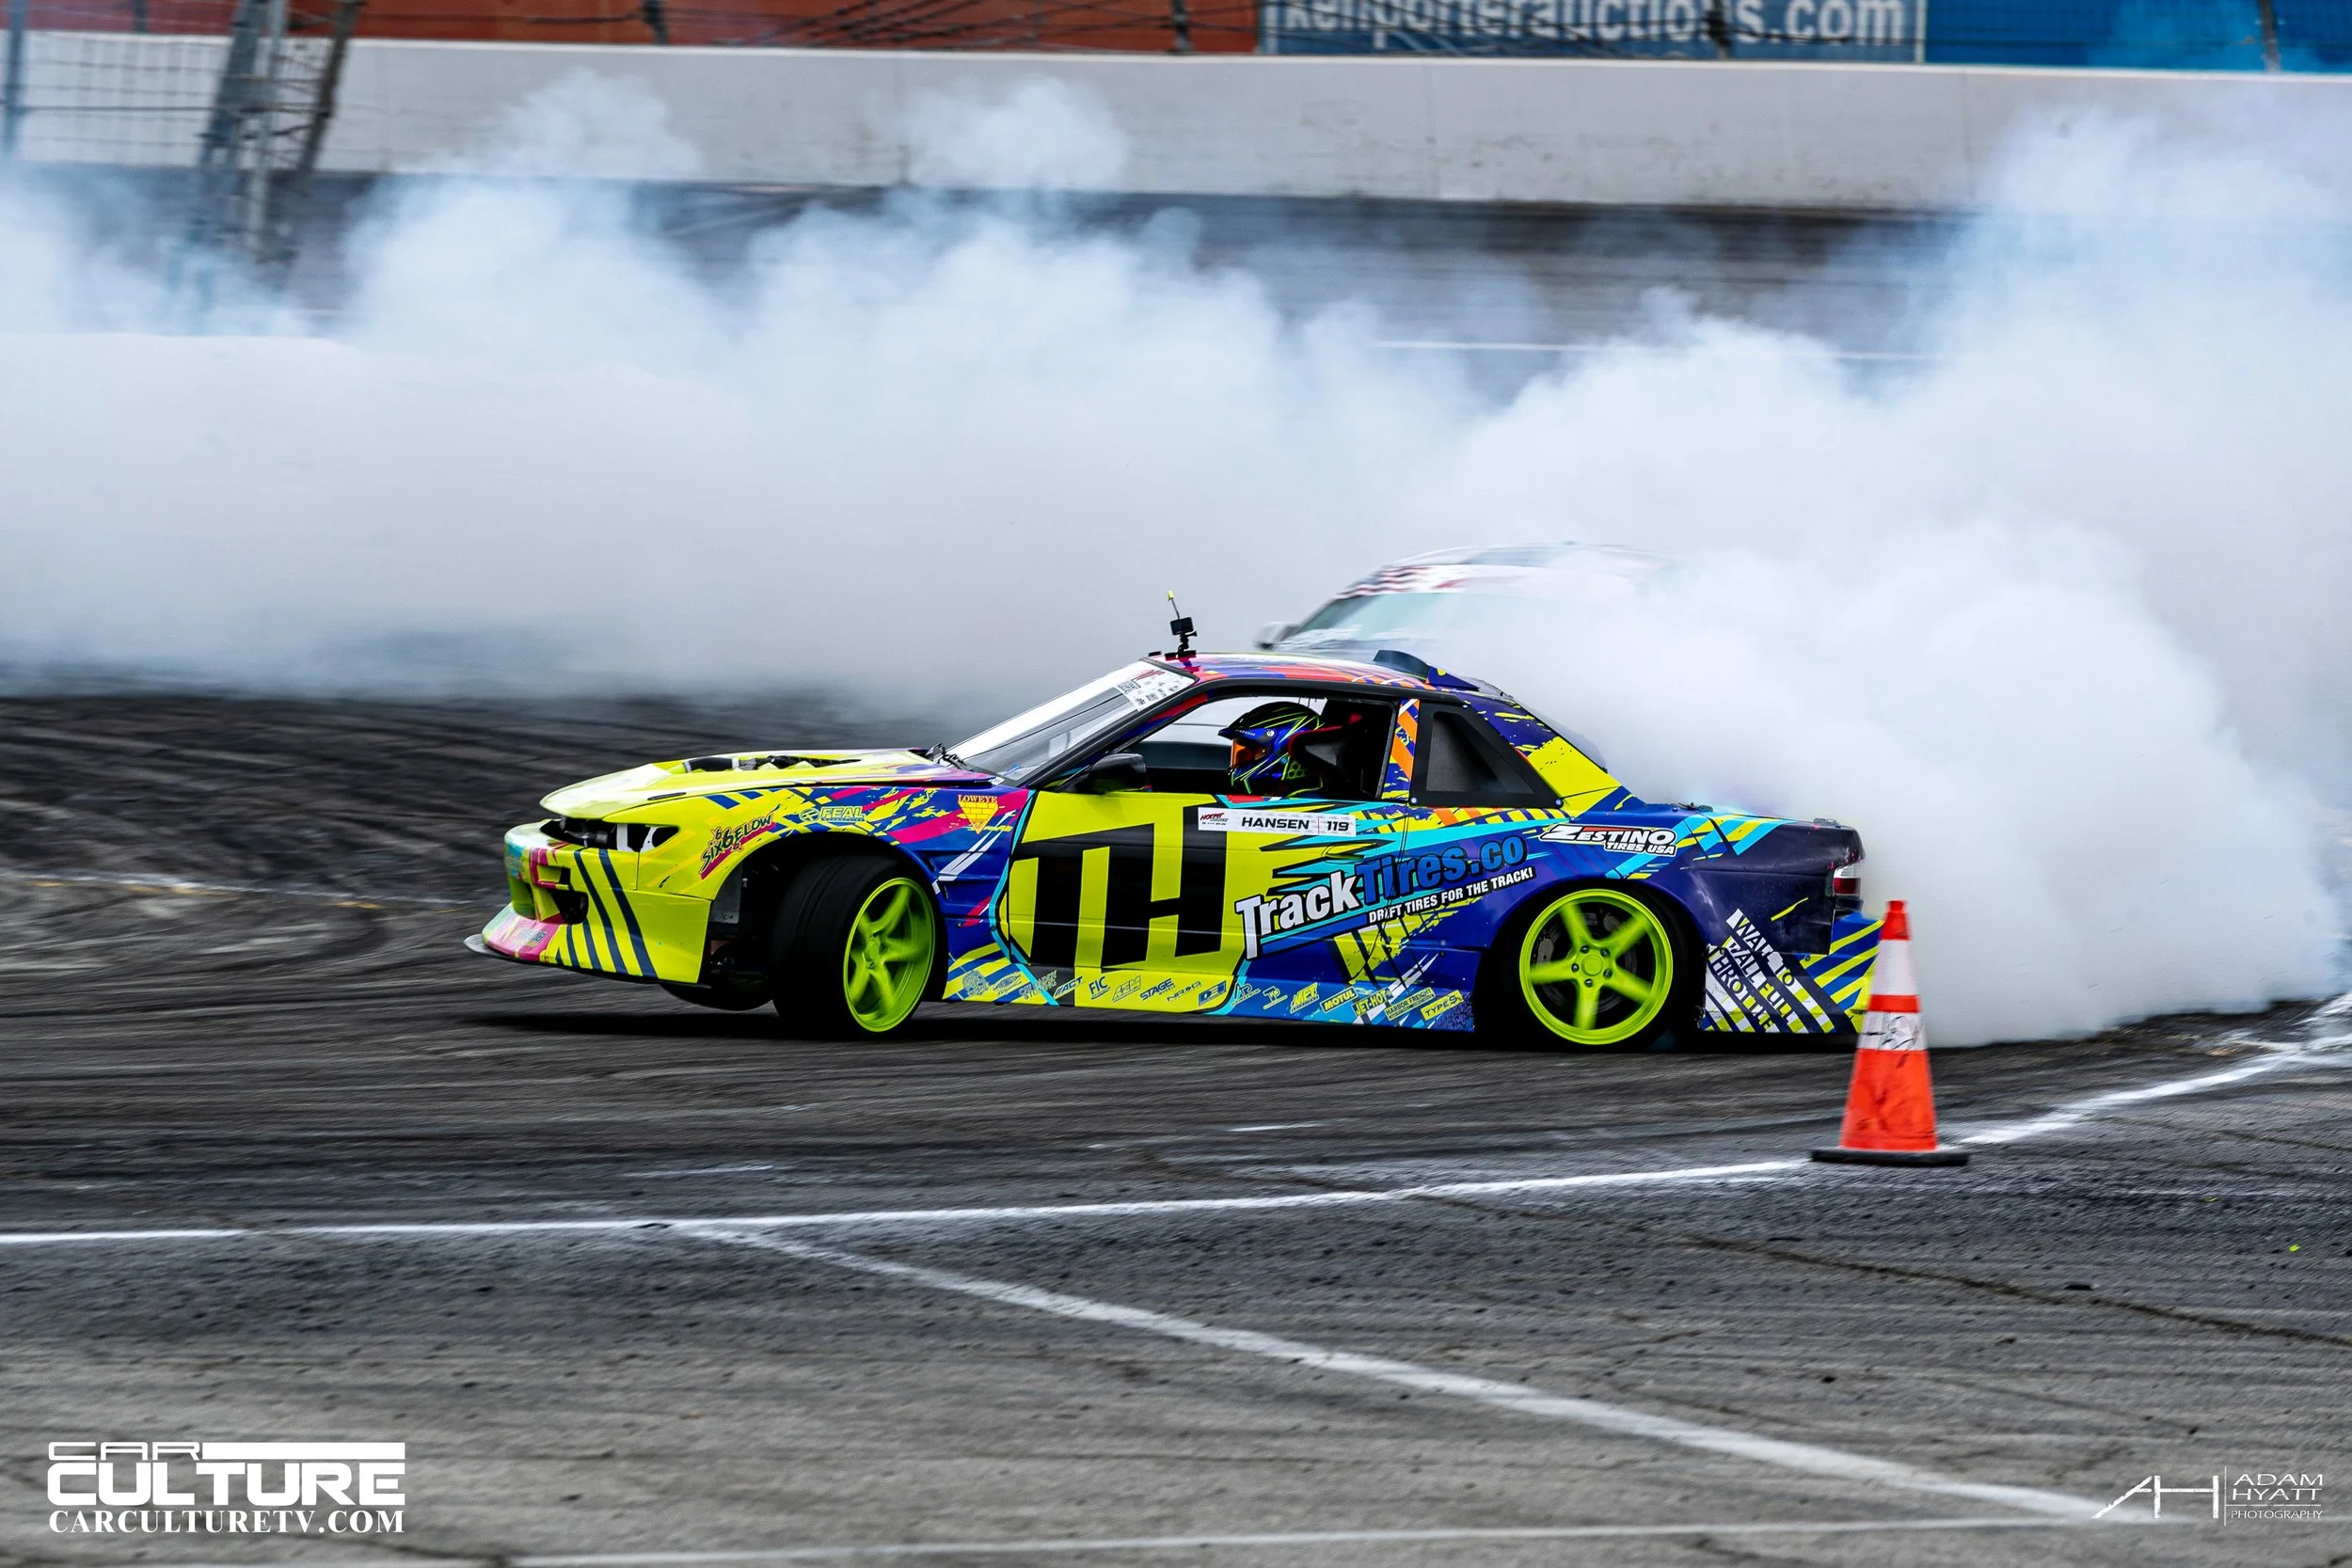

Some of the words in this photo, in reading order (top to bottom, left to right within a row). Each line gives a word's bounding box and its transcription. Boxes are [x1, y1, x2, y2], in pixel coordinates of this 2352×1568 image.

[958, 795, 997, 803] LOWEYE
[1242, 816, 1310, 830] HANSEN
[1327, 821, 1349, 832] 119
[1541, 825, 1676, 845] ZESTINO
[1606, 842, 1645, 852] TIRES
[1647, 845, 1675, 855] USA
[1405, 896, 1438, 914] TIRES
[1441, 888, 1463, 905] FOR
[1467, 881, 1488, 899] THE
[1490, 867, 1534, 893] TRACK!
[1089, 976, 1107, 995] FIC
[1140, 978, 1174, 1001] STAGE
[1324, 989, 1356, 1011] MOTUL
[1386, 999, 1408, 1016] HARBOR
[1409, 988, 1433, 1005] FREIGHT
